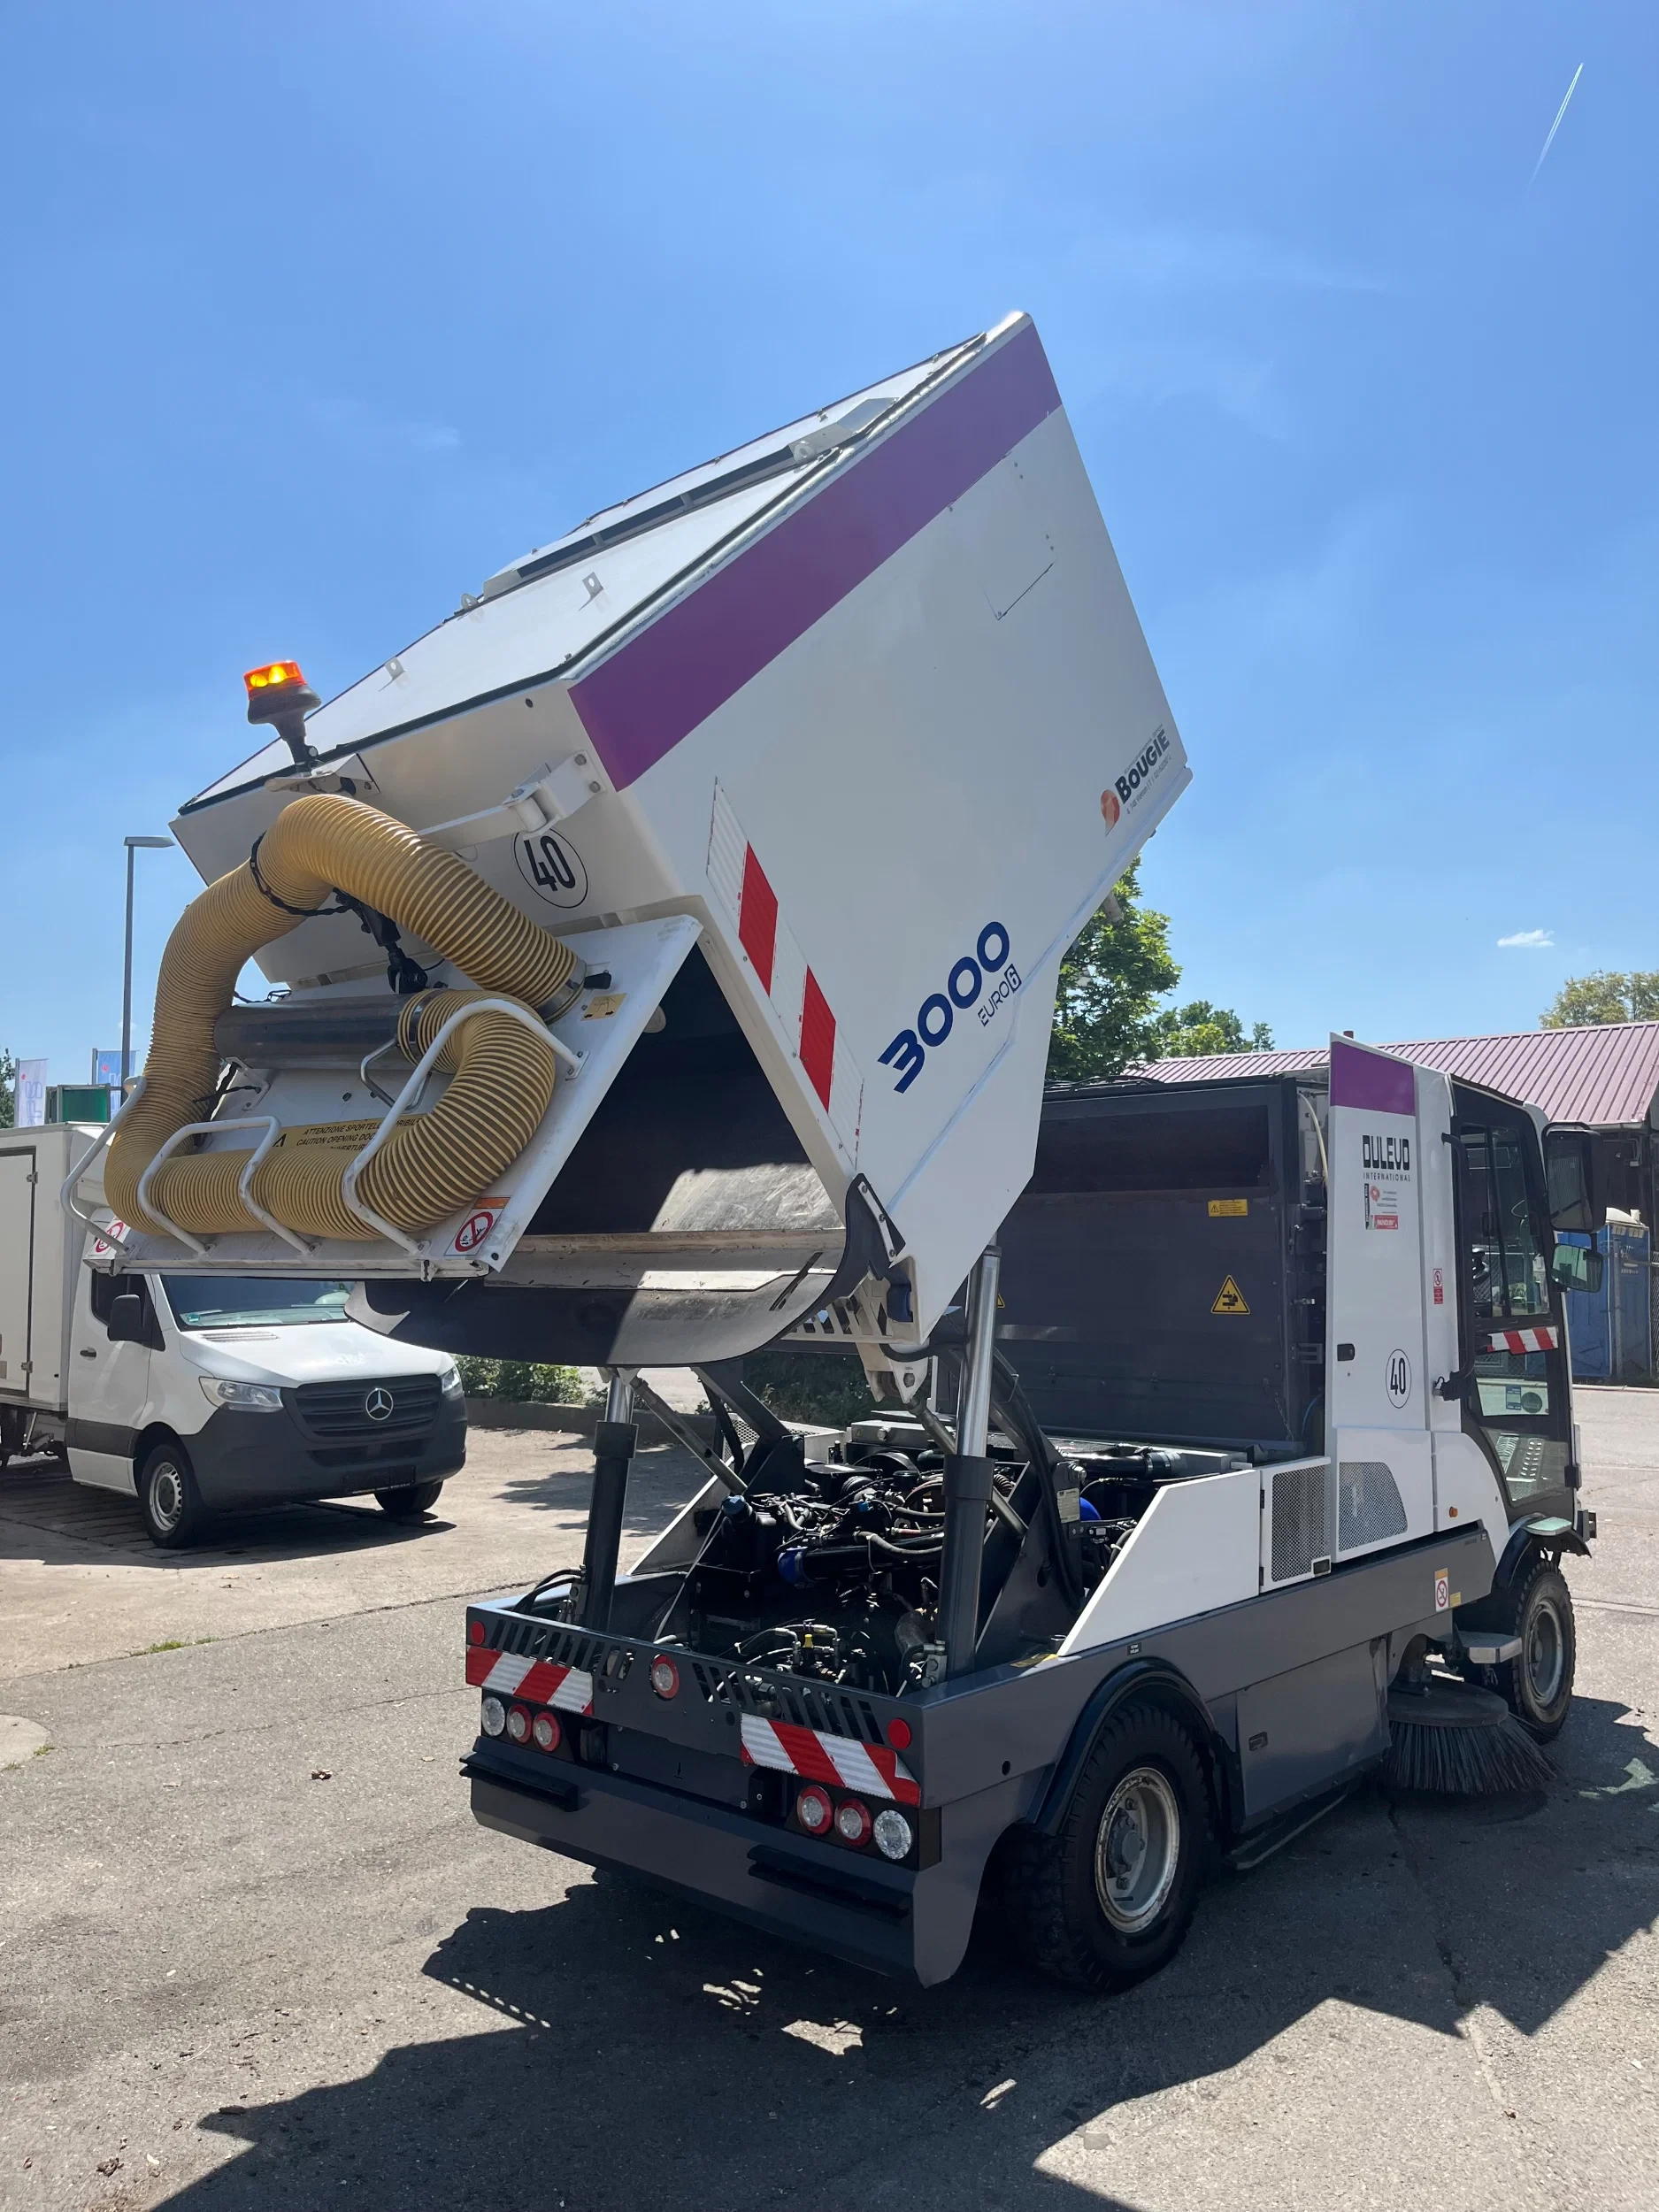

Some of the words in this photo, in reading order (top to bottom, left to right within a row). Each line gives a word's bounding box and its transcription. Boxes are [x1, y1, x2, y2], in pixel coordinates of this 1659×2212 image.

[1115, 729, 1170, 804] BOUGIE
[524, 835, 575, 892] 40
[877, 921, 1010, 1094] 3000
[303, 1125, 345, 1135] ATTENZIONE
[346, 1122, 380, 1132] SPORTELL
[327, 1134, 358, 1143] OPENING
[1363, 1135, 1409, 1171] DULEVO
[1363, 1172, 1410, 1182] INTERNATIONAL
[1390, 1357, 1406, 1395] 40
